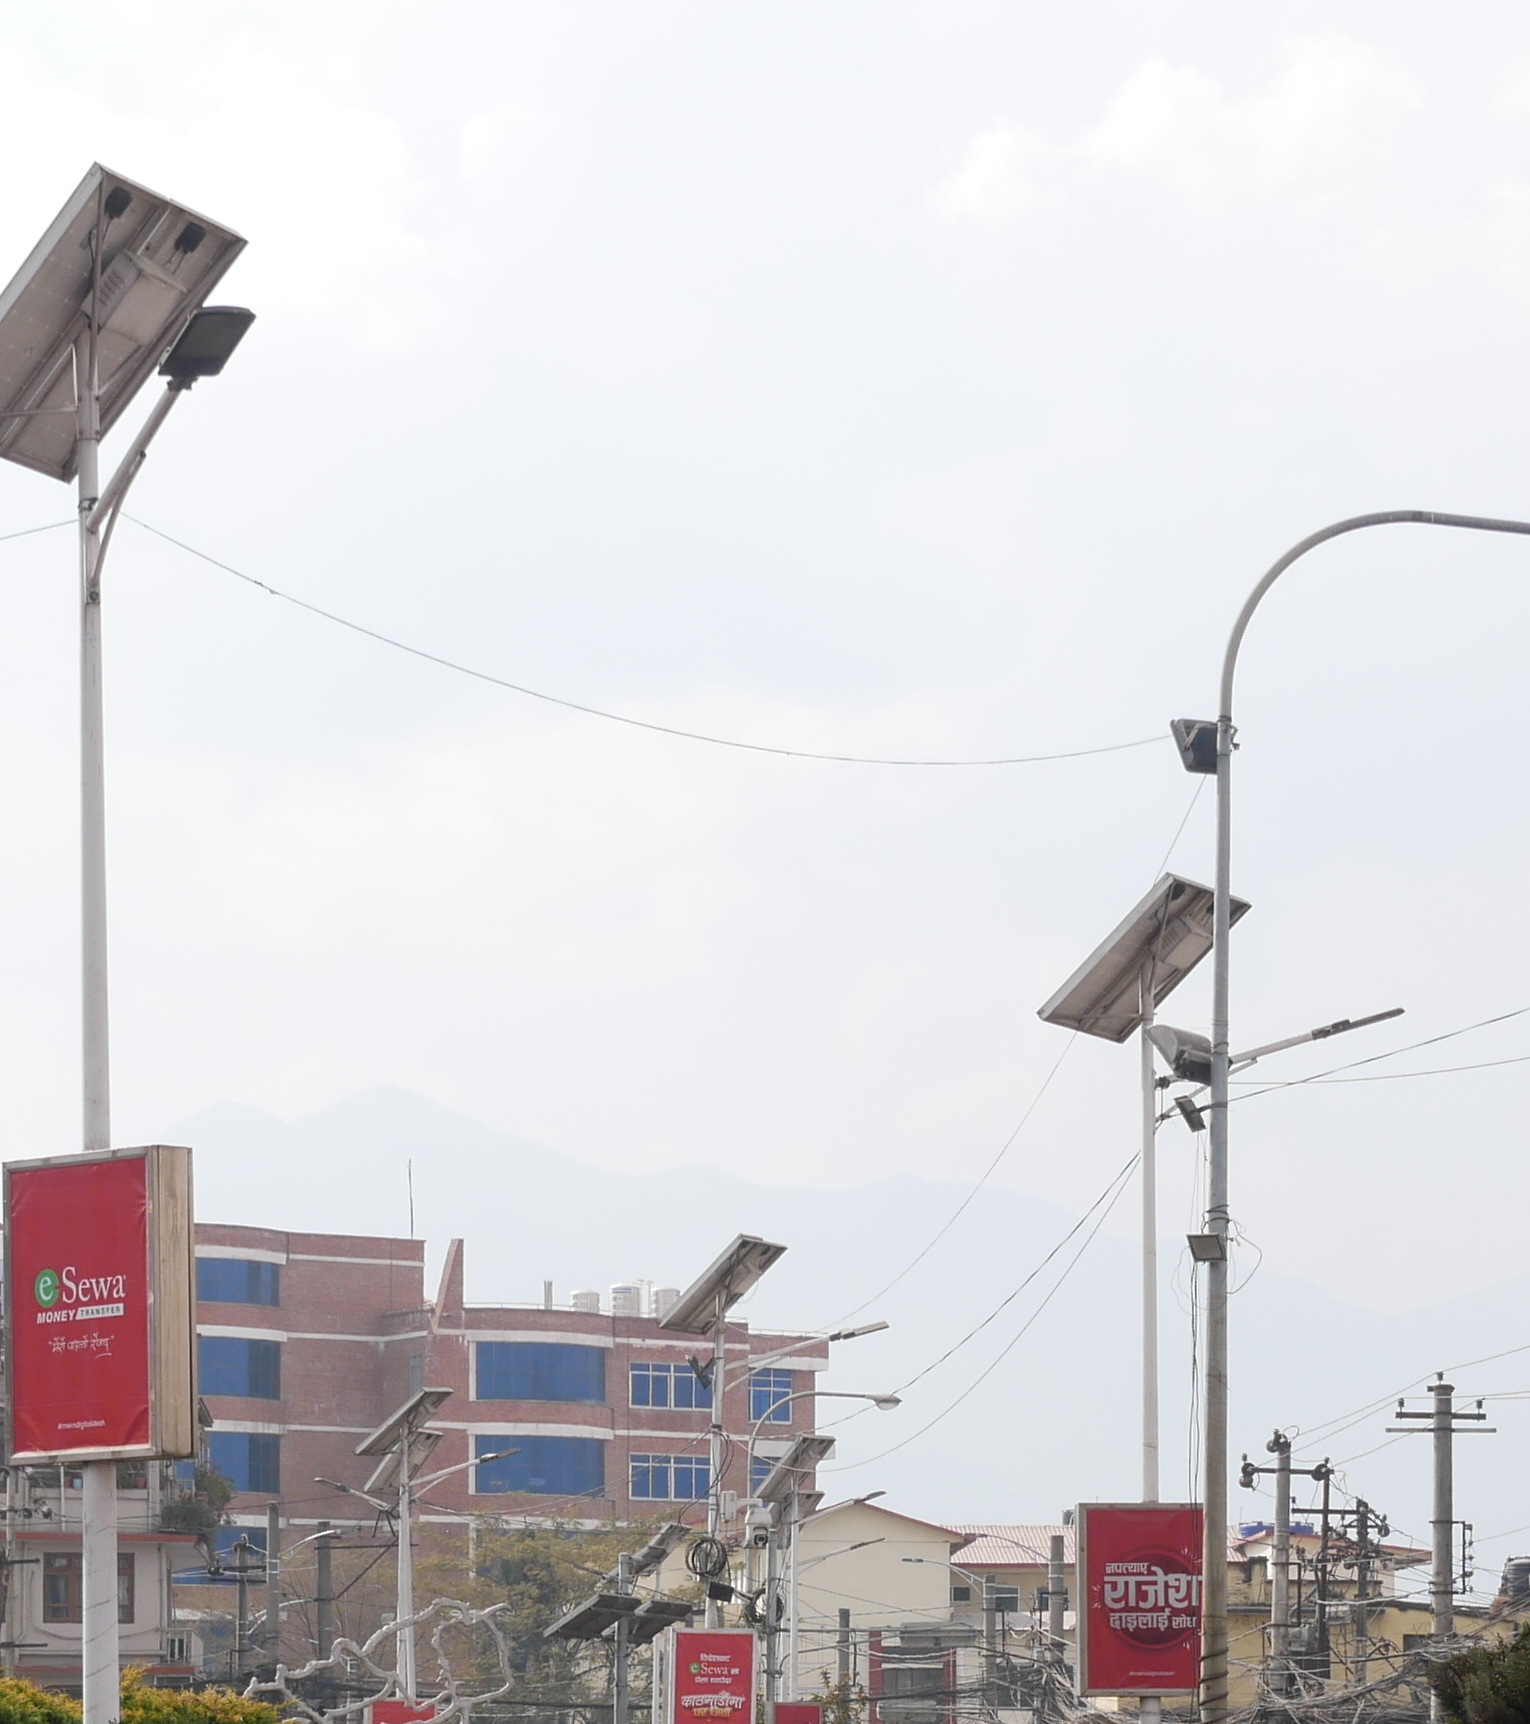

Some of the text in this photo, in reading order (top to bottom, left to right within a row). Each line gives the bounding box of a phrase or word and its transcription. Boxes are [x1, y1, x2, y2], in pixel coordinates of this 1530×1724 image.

[36, 1305, 122, 1324] MONEY TRANSFER
[1103, 1566, 1203, 1609] राजेश
[1109, 1607, 1172, 1632] दाइलाई
